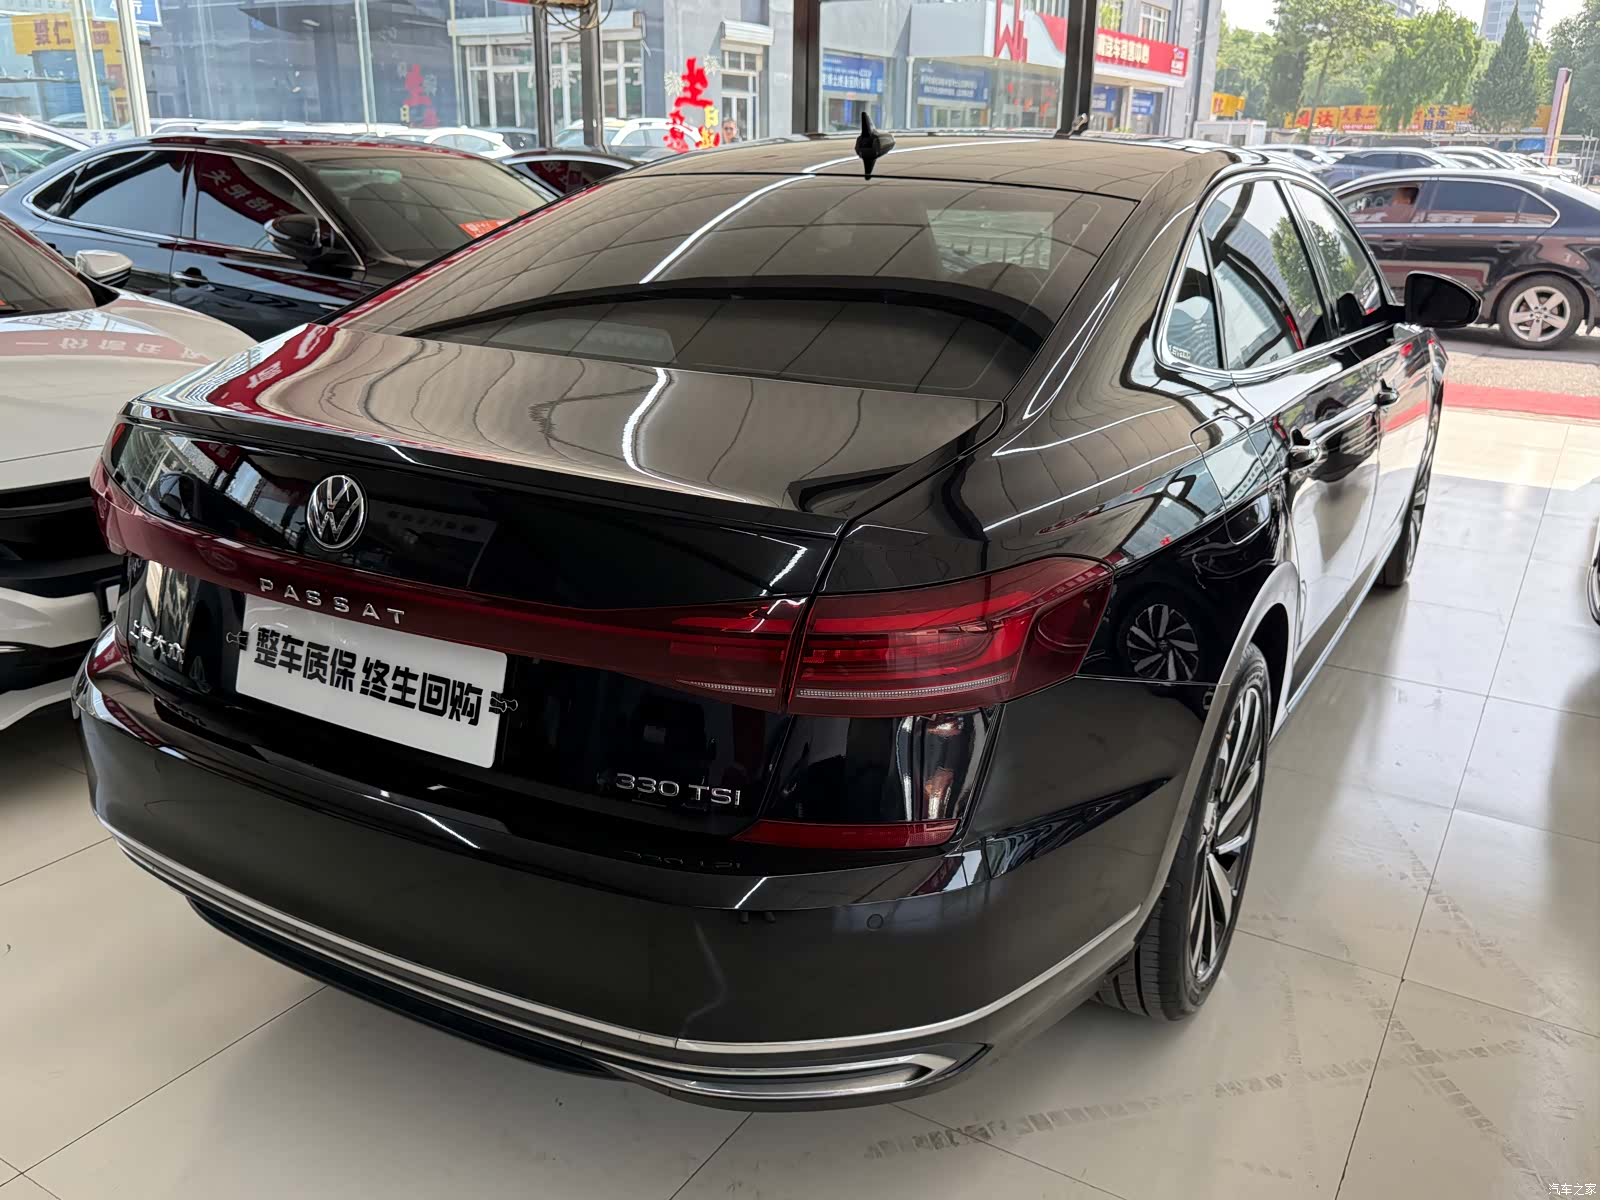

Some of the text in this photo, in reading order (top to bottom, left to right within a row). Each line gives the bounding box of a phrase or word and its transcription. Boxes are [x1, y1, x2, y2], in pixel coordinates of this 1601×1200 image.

[259, 577, 405, 625] PASSAT
[129, 619, 185, 665] 上汽大众
[253, 626, 484, 727] 整车质保 终生回购
[615, 772, 741, 806] 330 TSI
